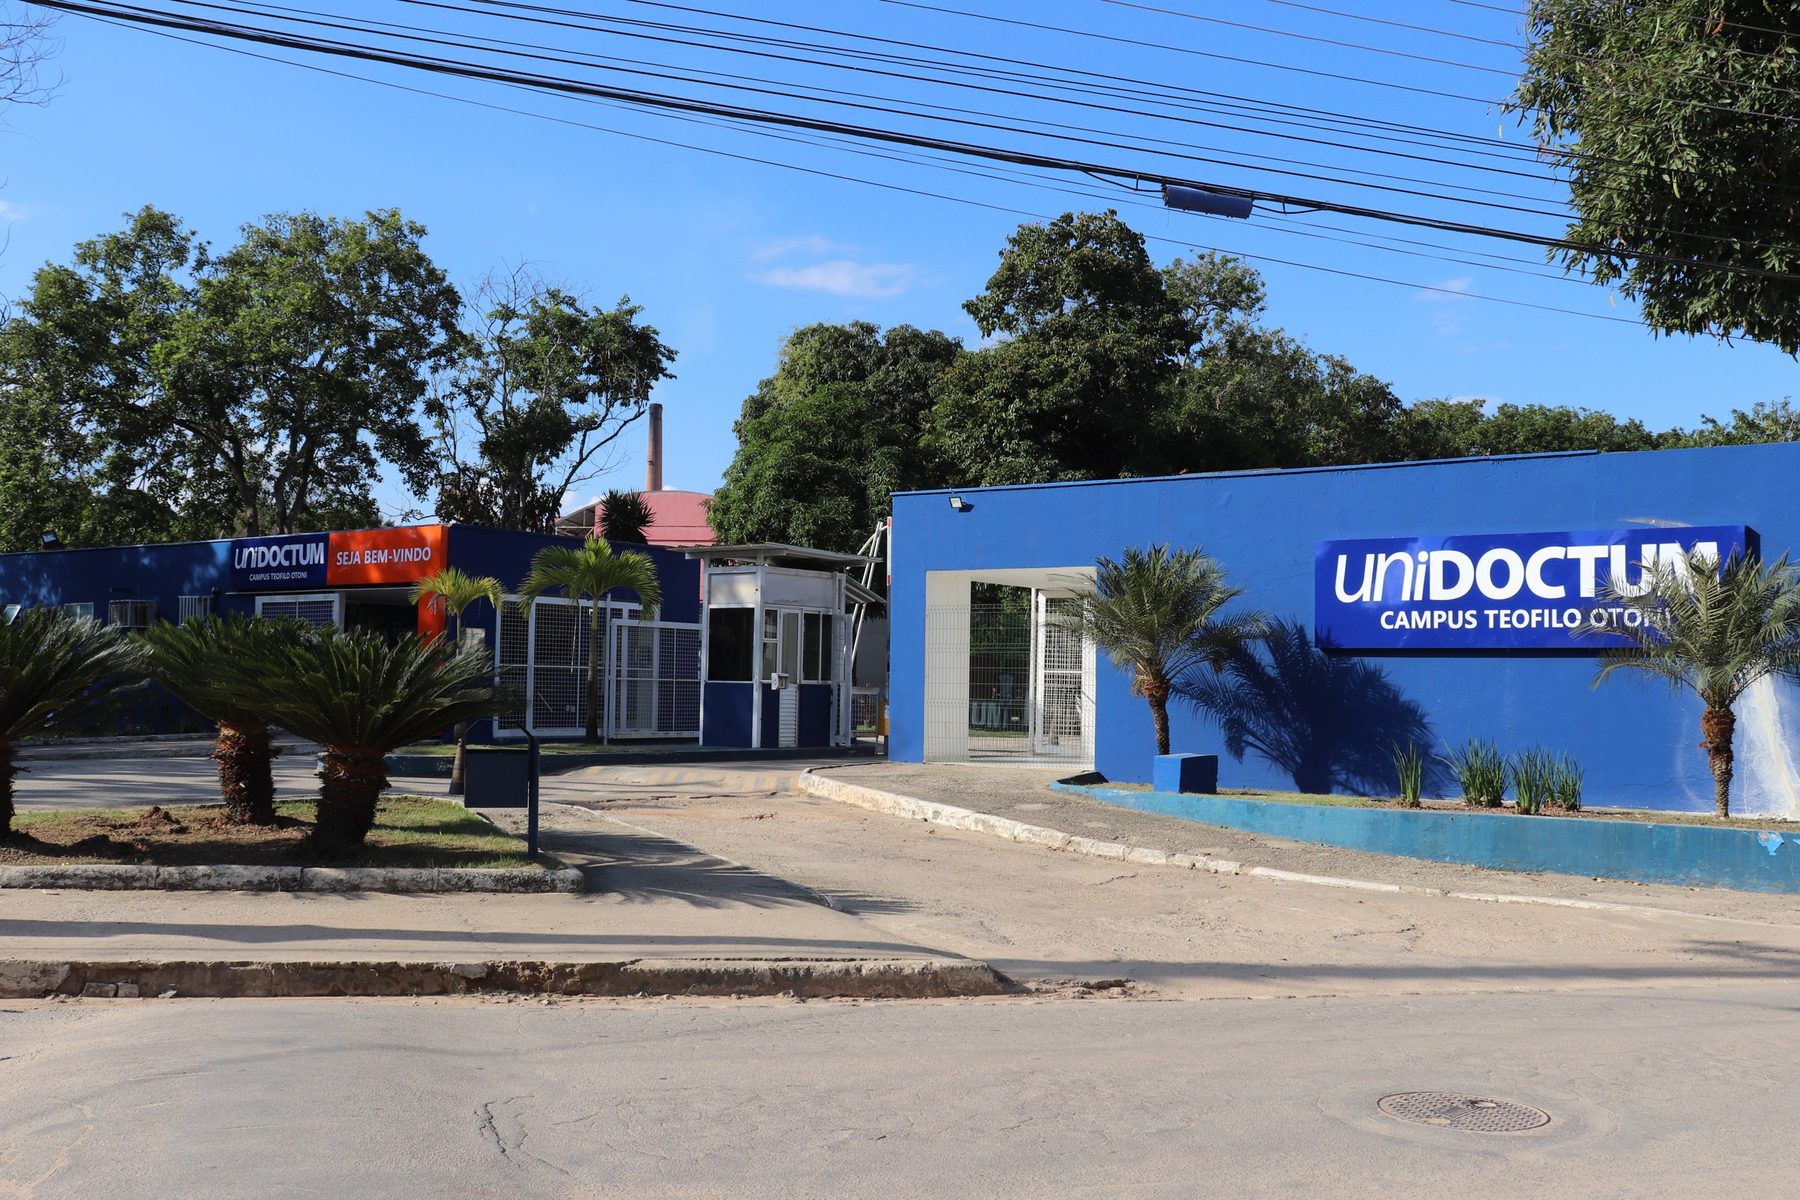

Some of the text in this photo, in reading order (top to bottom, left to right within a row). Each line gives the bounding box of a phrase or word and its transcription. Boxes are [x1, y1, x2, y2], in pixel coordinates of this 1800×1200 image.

[234, 542, 325, 570] uniDOCTUM
[336, 546, 432, 566] SEJA BEM-VINDO
[249, 571, 307, 581] CAMPUS TEOFILO OTONI
[1380, 607, 1670, 630] CAMPUS TEOFILO OTO
